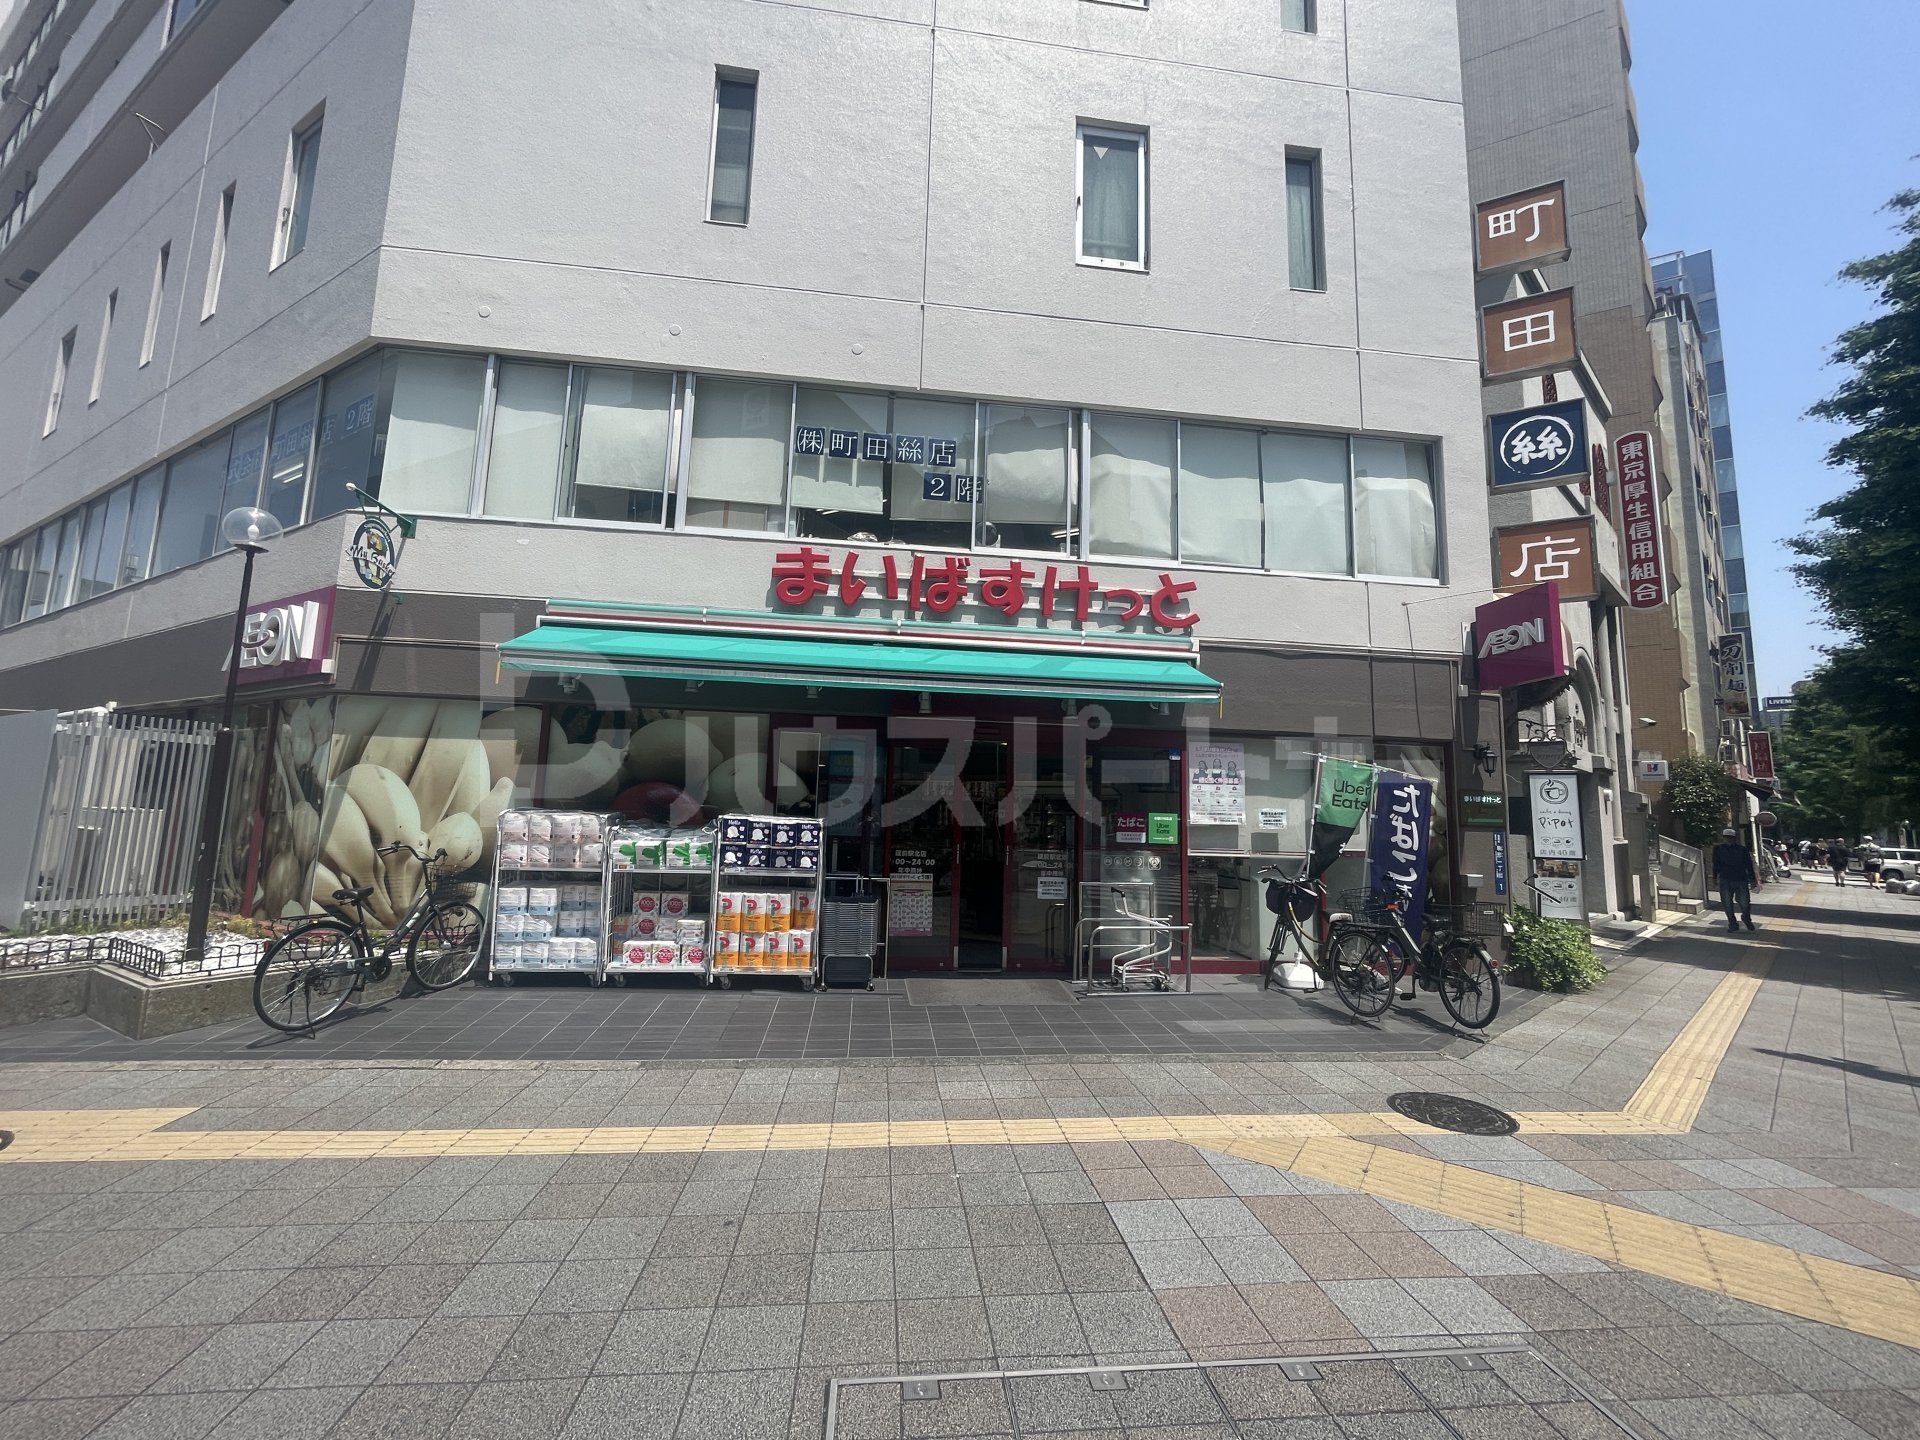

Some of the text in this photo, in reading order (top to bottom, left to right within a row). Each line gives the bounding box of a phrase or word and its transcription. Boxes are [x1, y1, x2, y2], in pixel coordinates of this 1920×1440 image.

[1488, 198, 1555, 242] 町
[1503, 310, 1555, 352] 田
[928, 476, 983, 502] 2階
[1621, 441, 1660, 599] 東京厚生信用組合
[1510, 536, 1581, 582] 店
[772, 547, 1201, 629] まいばすけっと
[1331, 794, 1367, 810] Eats
[1334, 780, 1371, 796] Uber
